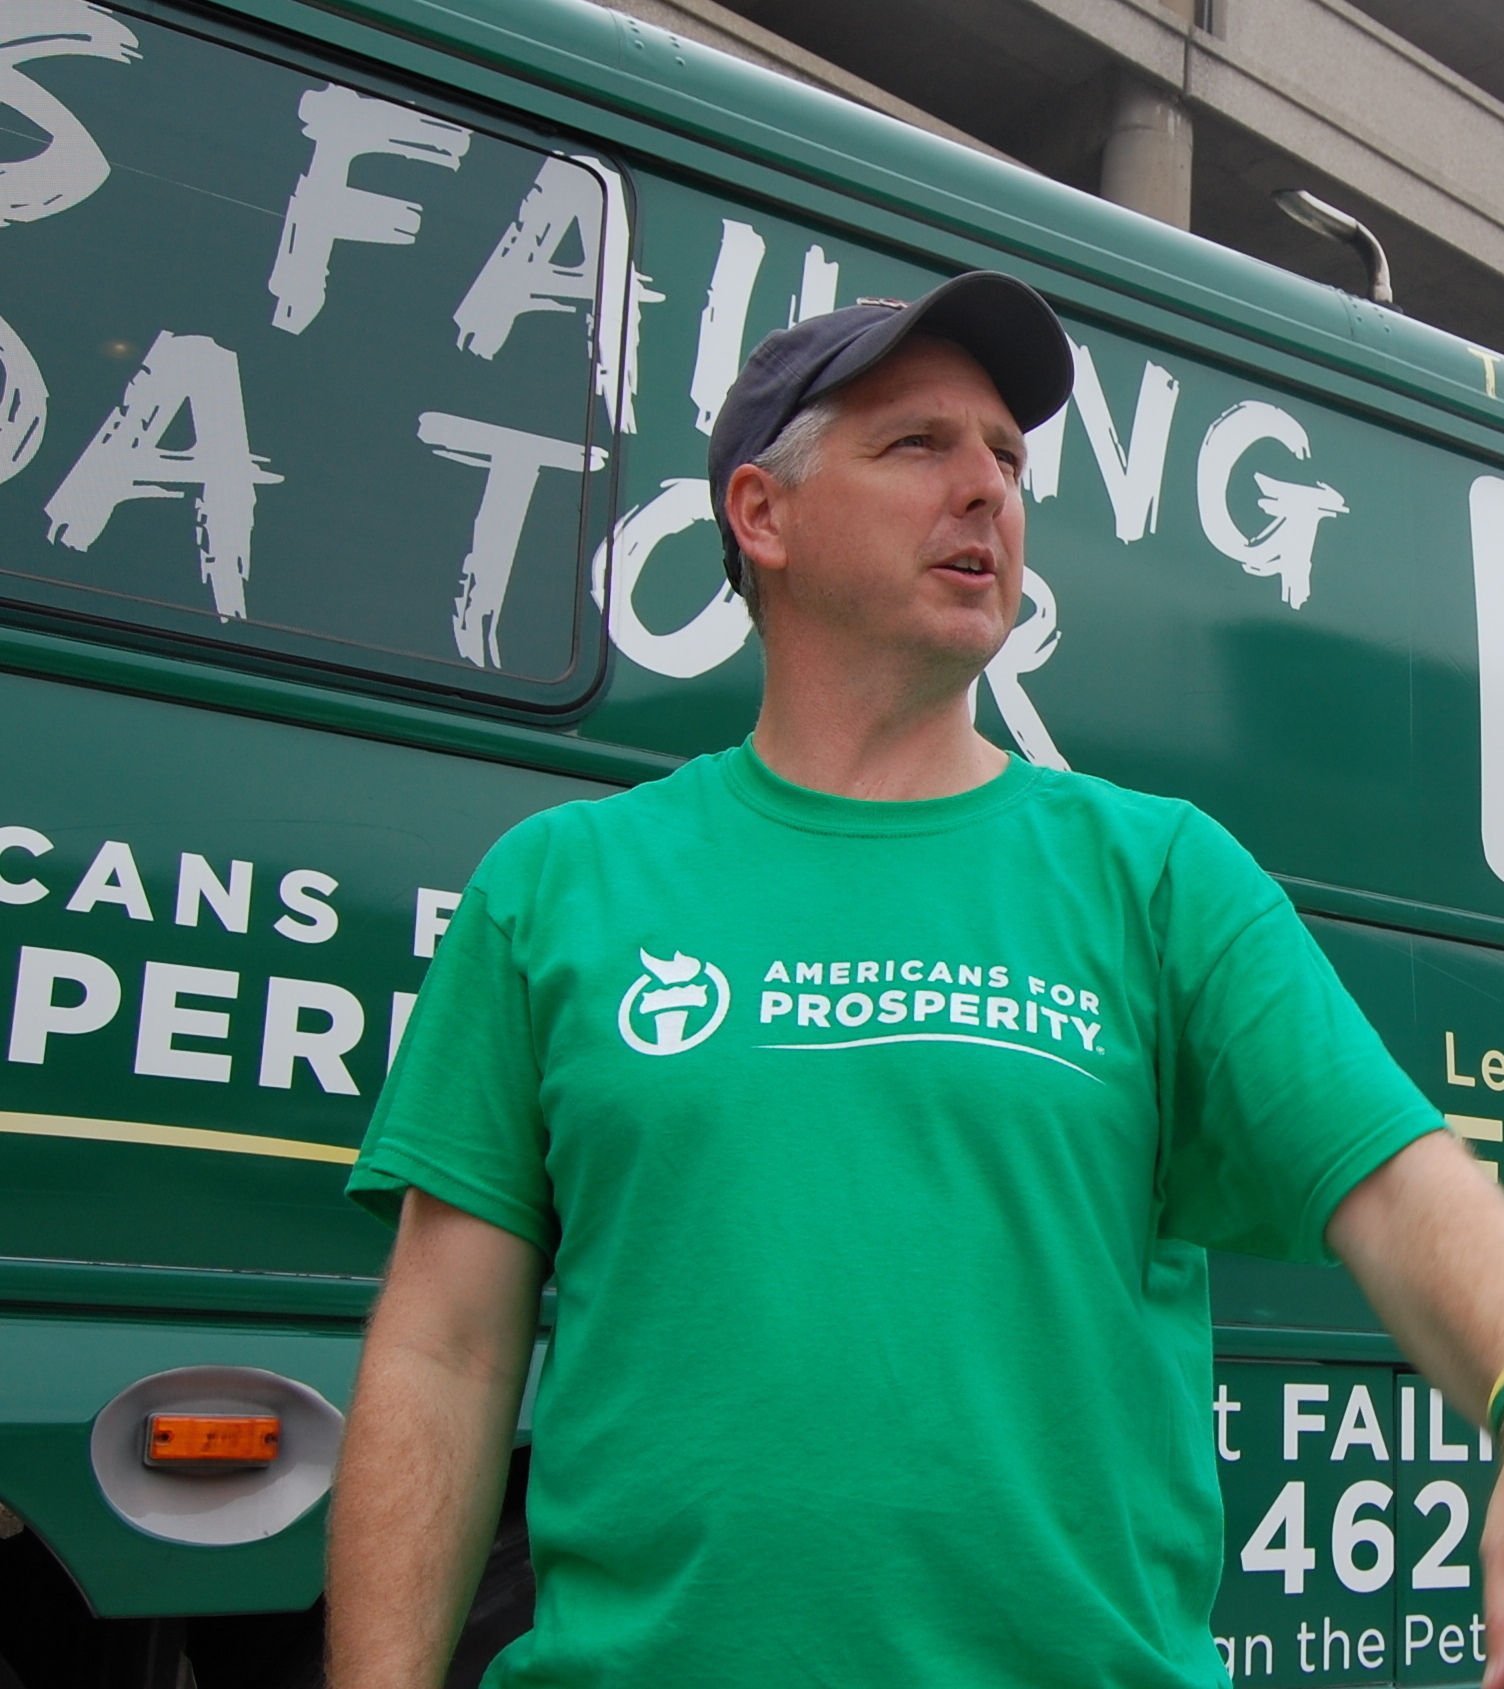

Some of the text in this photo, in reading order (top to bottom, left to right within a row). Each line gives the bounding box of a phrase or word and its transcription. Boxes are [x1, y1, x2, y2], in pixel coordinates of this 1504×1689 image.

[268, 82, 1350, 610] FAING
[0, 315, 1072, 772] A TOR
[763, 960, 1101, 1016] AMERICANS FOR
[1297, 1616, 1386, 1673] the
